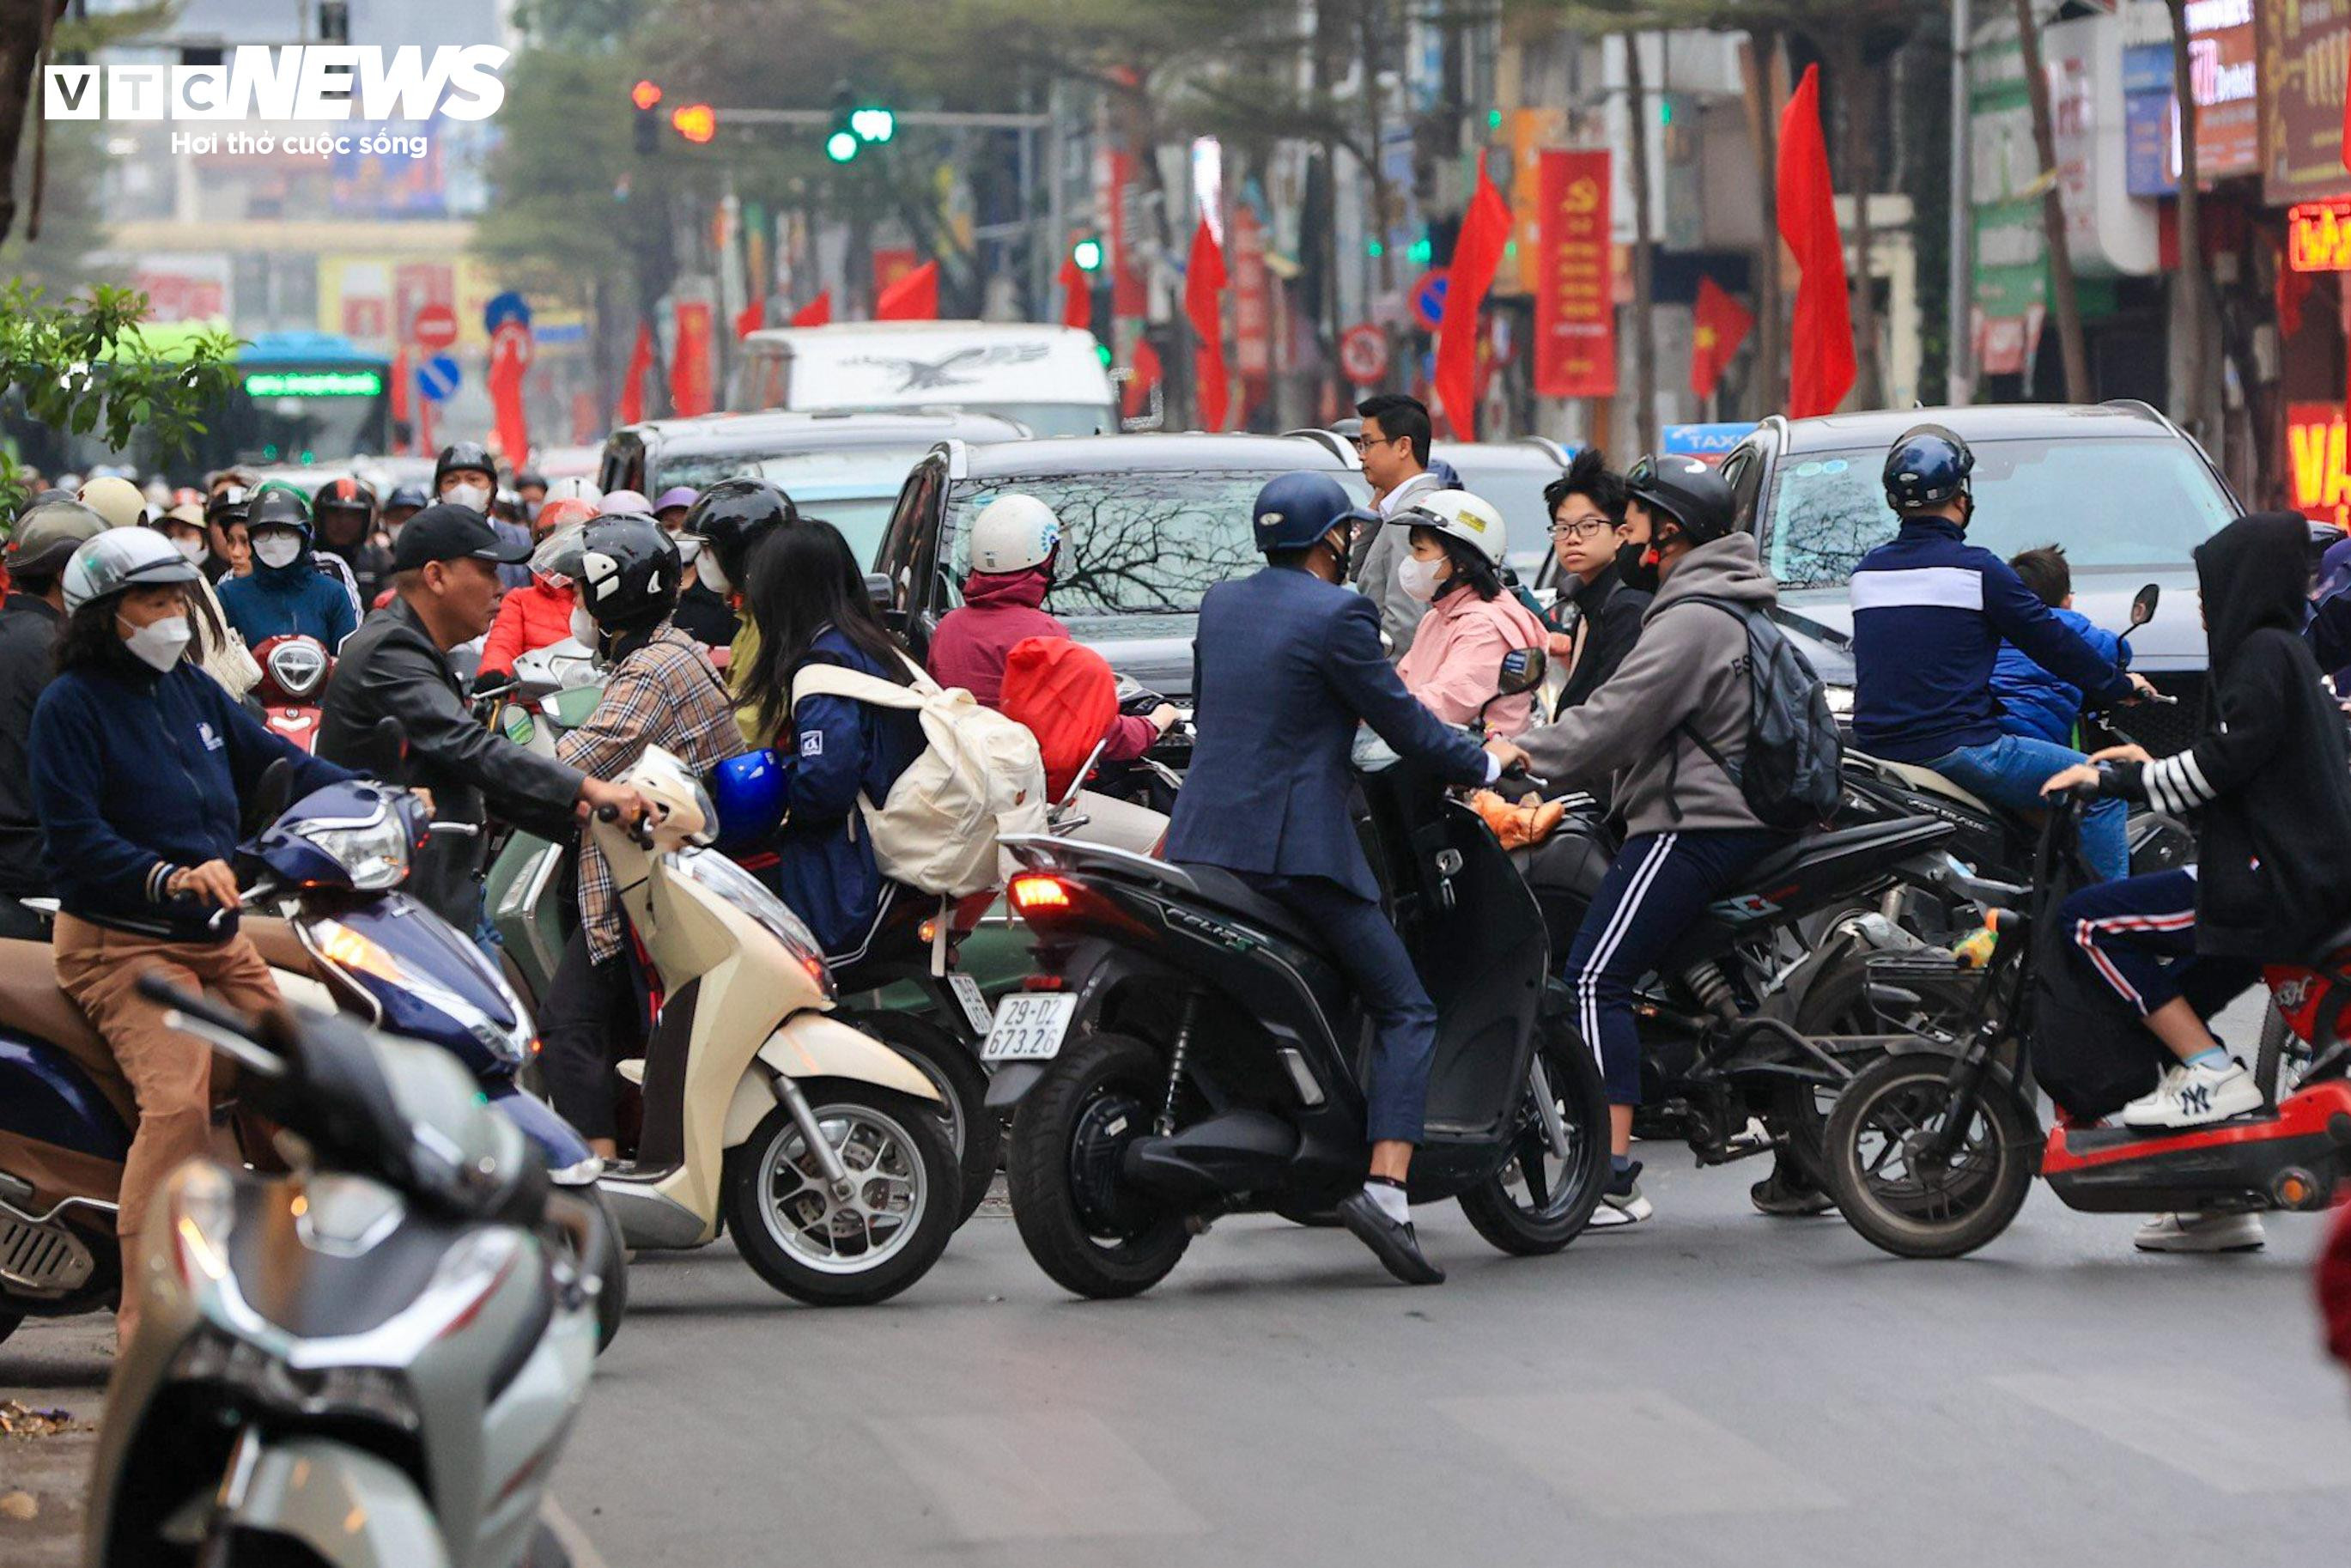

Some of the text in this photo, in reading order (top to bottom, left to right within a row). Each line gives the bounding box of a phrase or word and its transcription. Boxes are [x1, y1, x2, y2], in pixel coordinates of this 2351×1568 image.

[1689, 435, 1747, 449] TAX
[988, 1029, 1057, 1054] 673.26
[2181, 1083, 2210, 1115] NY
